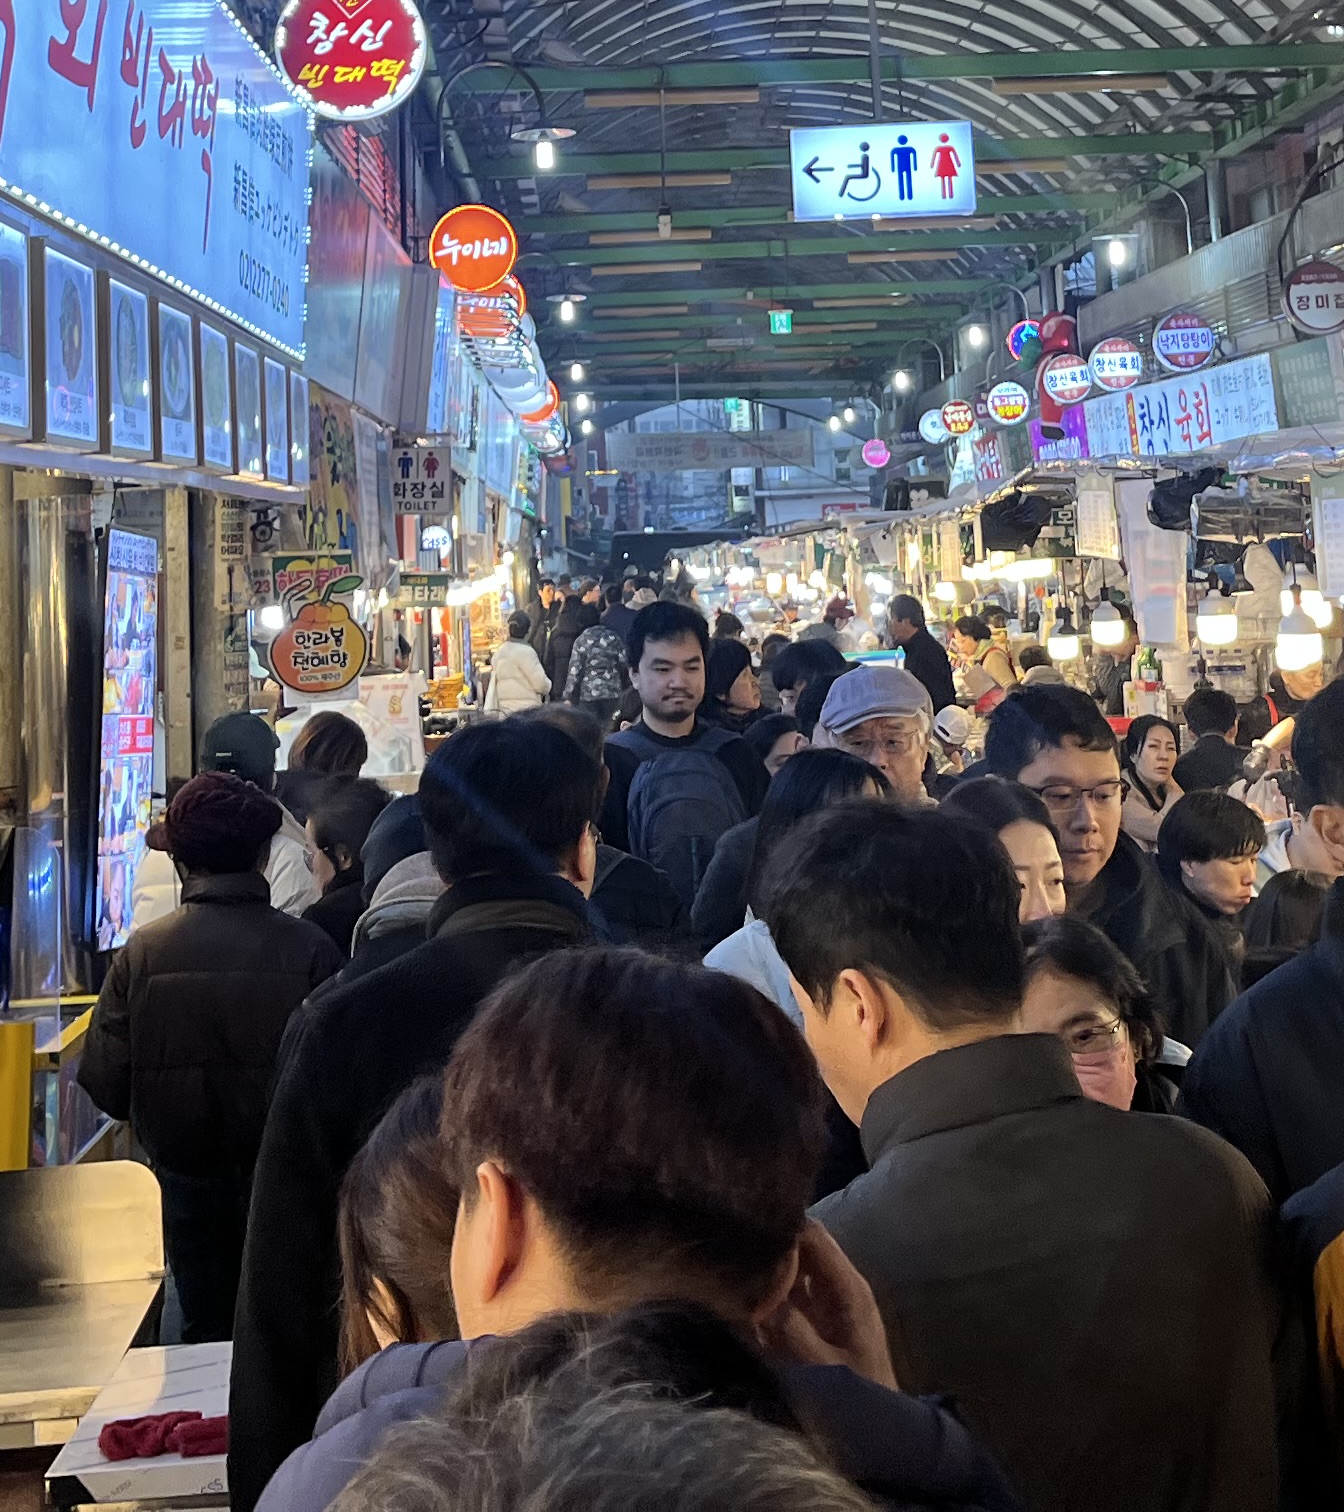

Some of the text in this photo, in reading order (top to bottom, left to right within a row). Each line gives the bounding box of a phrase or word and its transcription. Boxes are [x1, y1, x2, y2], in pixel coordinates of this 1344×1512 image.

[307, 11, 393, 56] 창신
[298, 58, 406, 96] 빈대떡
[1159, 331, 1211, 350] 낙지탕탕이
[1095, 356, 1140, 373] 창신육회
[1048, 368, 1089, 388] 창신육회
[1173, 382, 1213, 452] 육회
[393, 481, 445, 499] 화장실
[397, 500, 437, 511] TOILET
[295, 626, 344, 650] 한라봉
[292, 649, 348, 671] 천혜향
